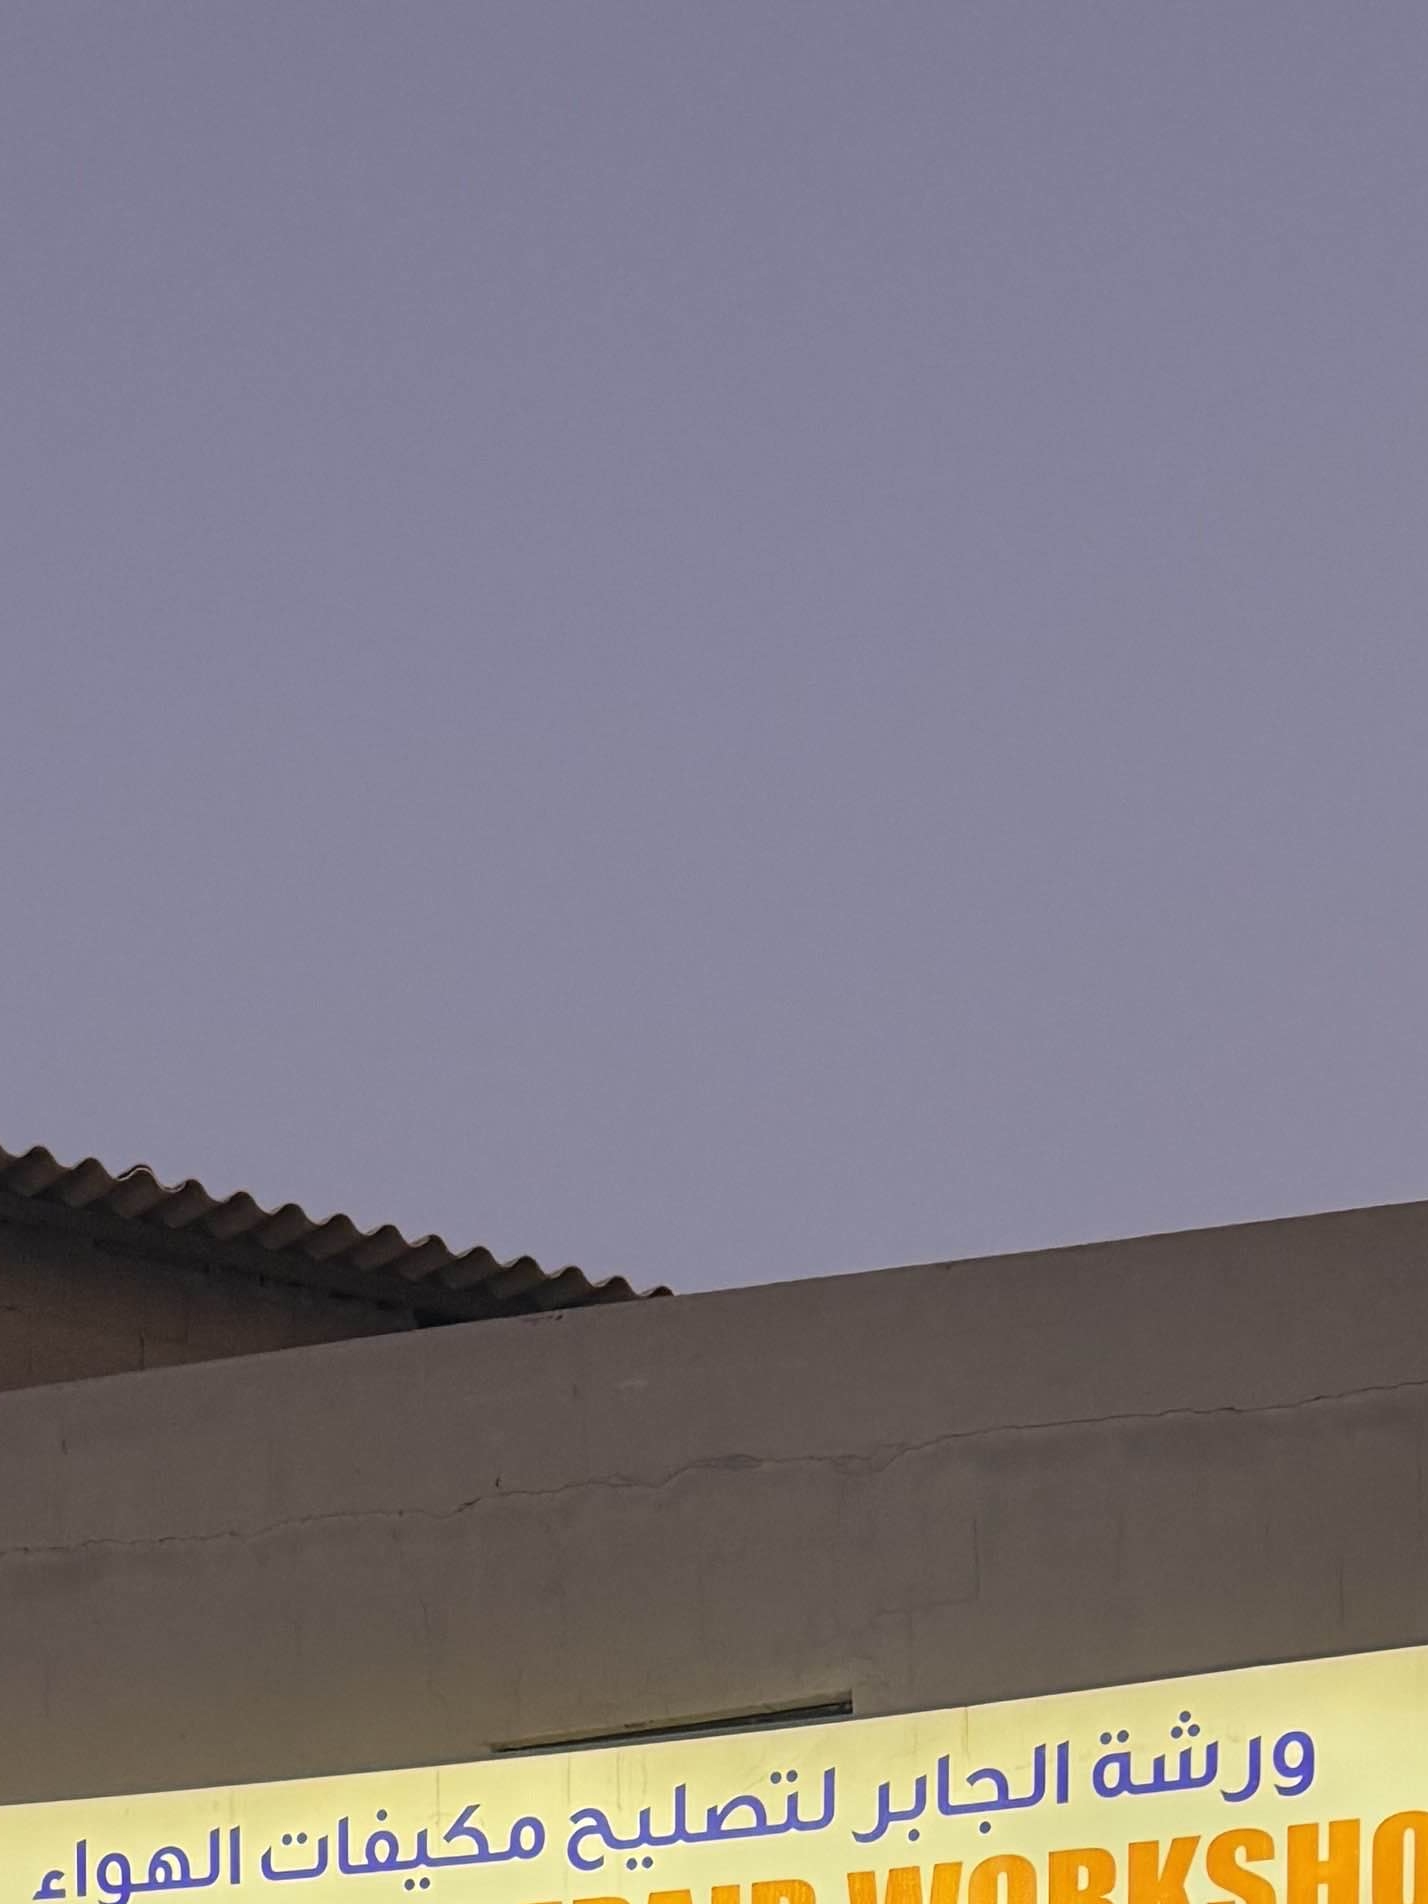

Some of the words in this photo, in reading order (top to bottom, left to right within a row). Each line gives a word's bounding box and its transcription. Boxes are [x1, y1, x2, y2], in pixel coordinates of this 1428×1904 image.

[852, 1742, 1069, 1843] الجابر
[1091, 1710, 1315, 1802] ورشة
[261, 1804, 545, 1892] مكيفات
[567, 1767, 836, 1871] لتصليح
